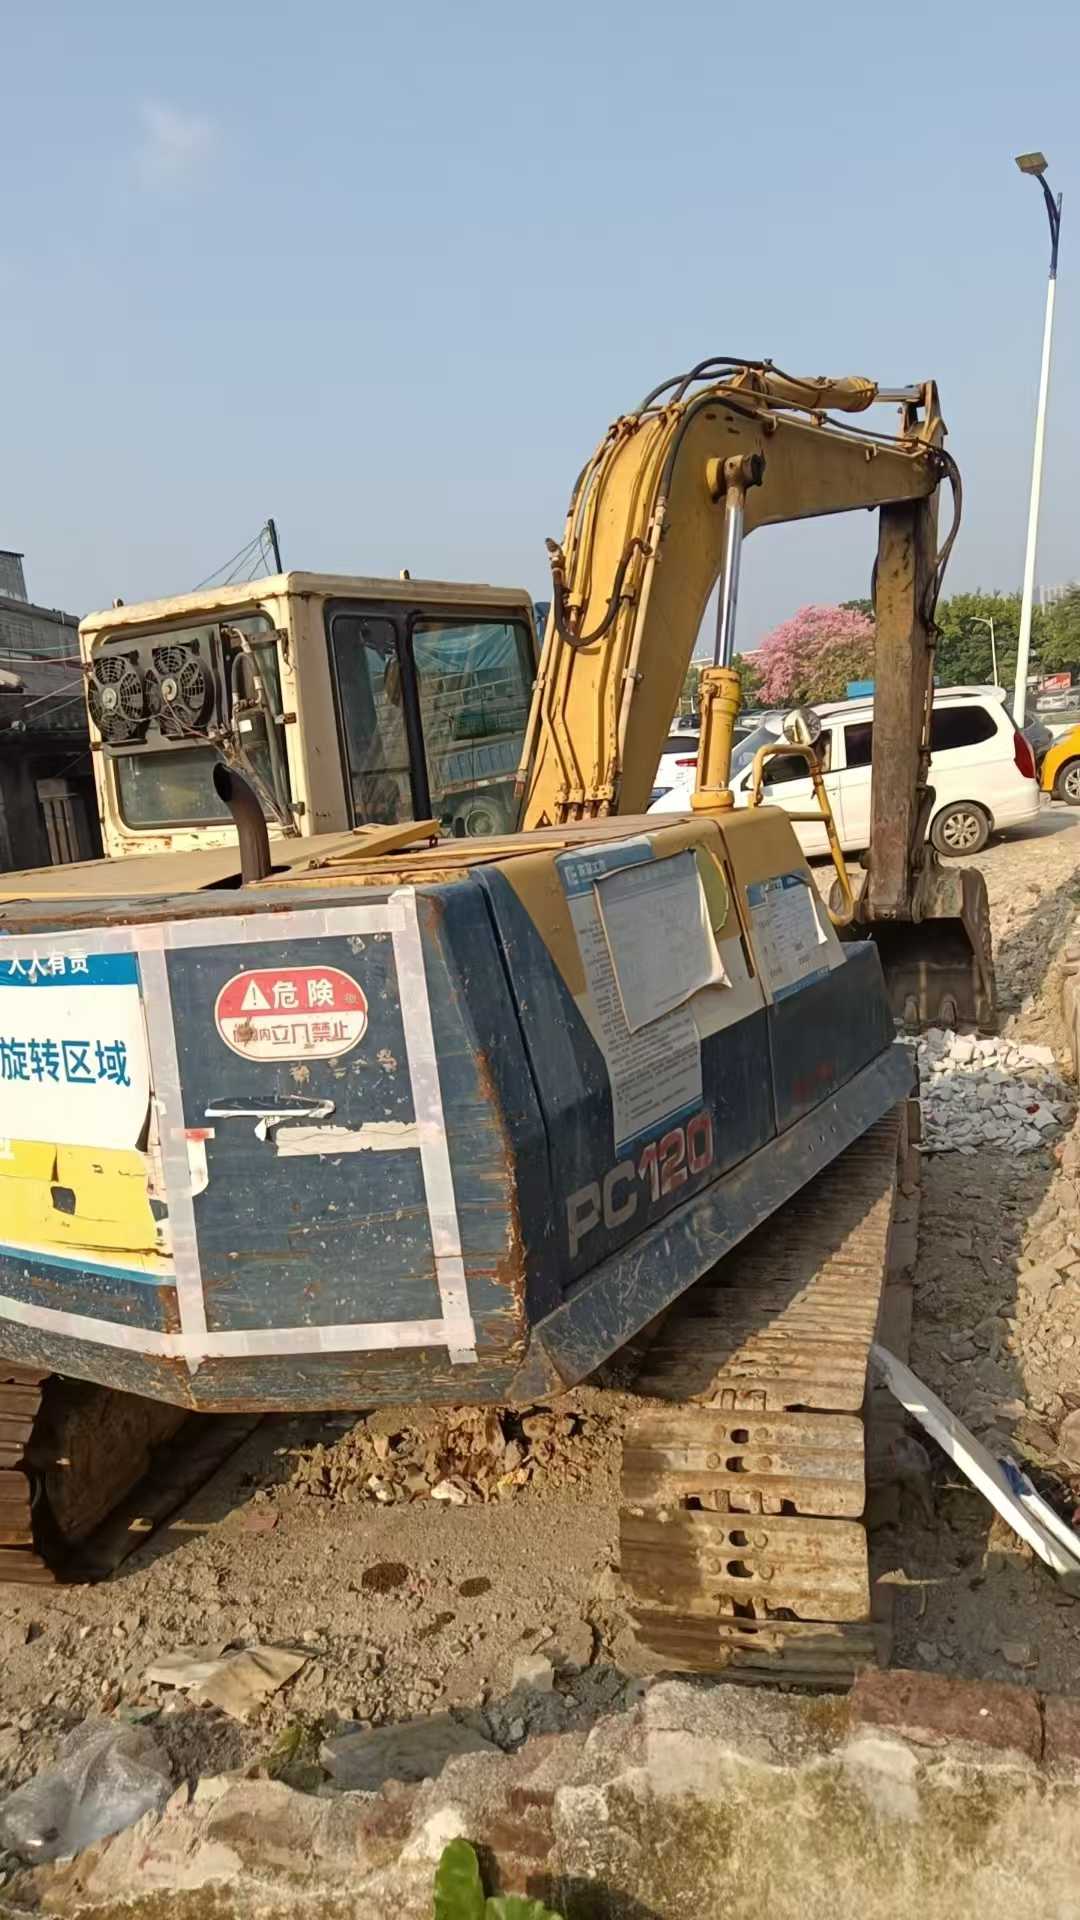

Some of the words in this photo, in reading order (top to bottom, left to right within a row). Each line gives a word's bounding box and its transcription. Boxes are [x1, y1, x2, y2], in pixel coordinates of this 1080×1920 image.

[0, 1037, 131, 1087] 旋转区域
[566, 1111, 714, 1261] PC120
